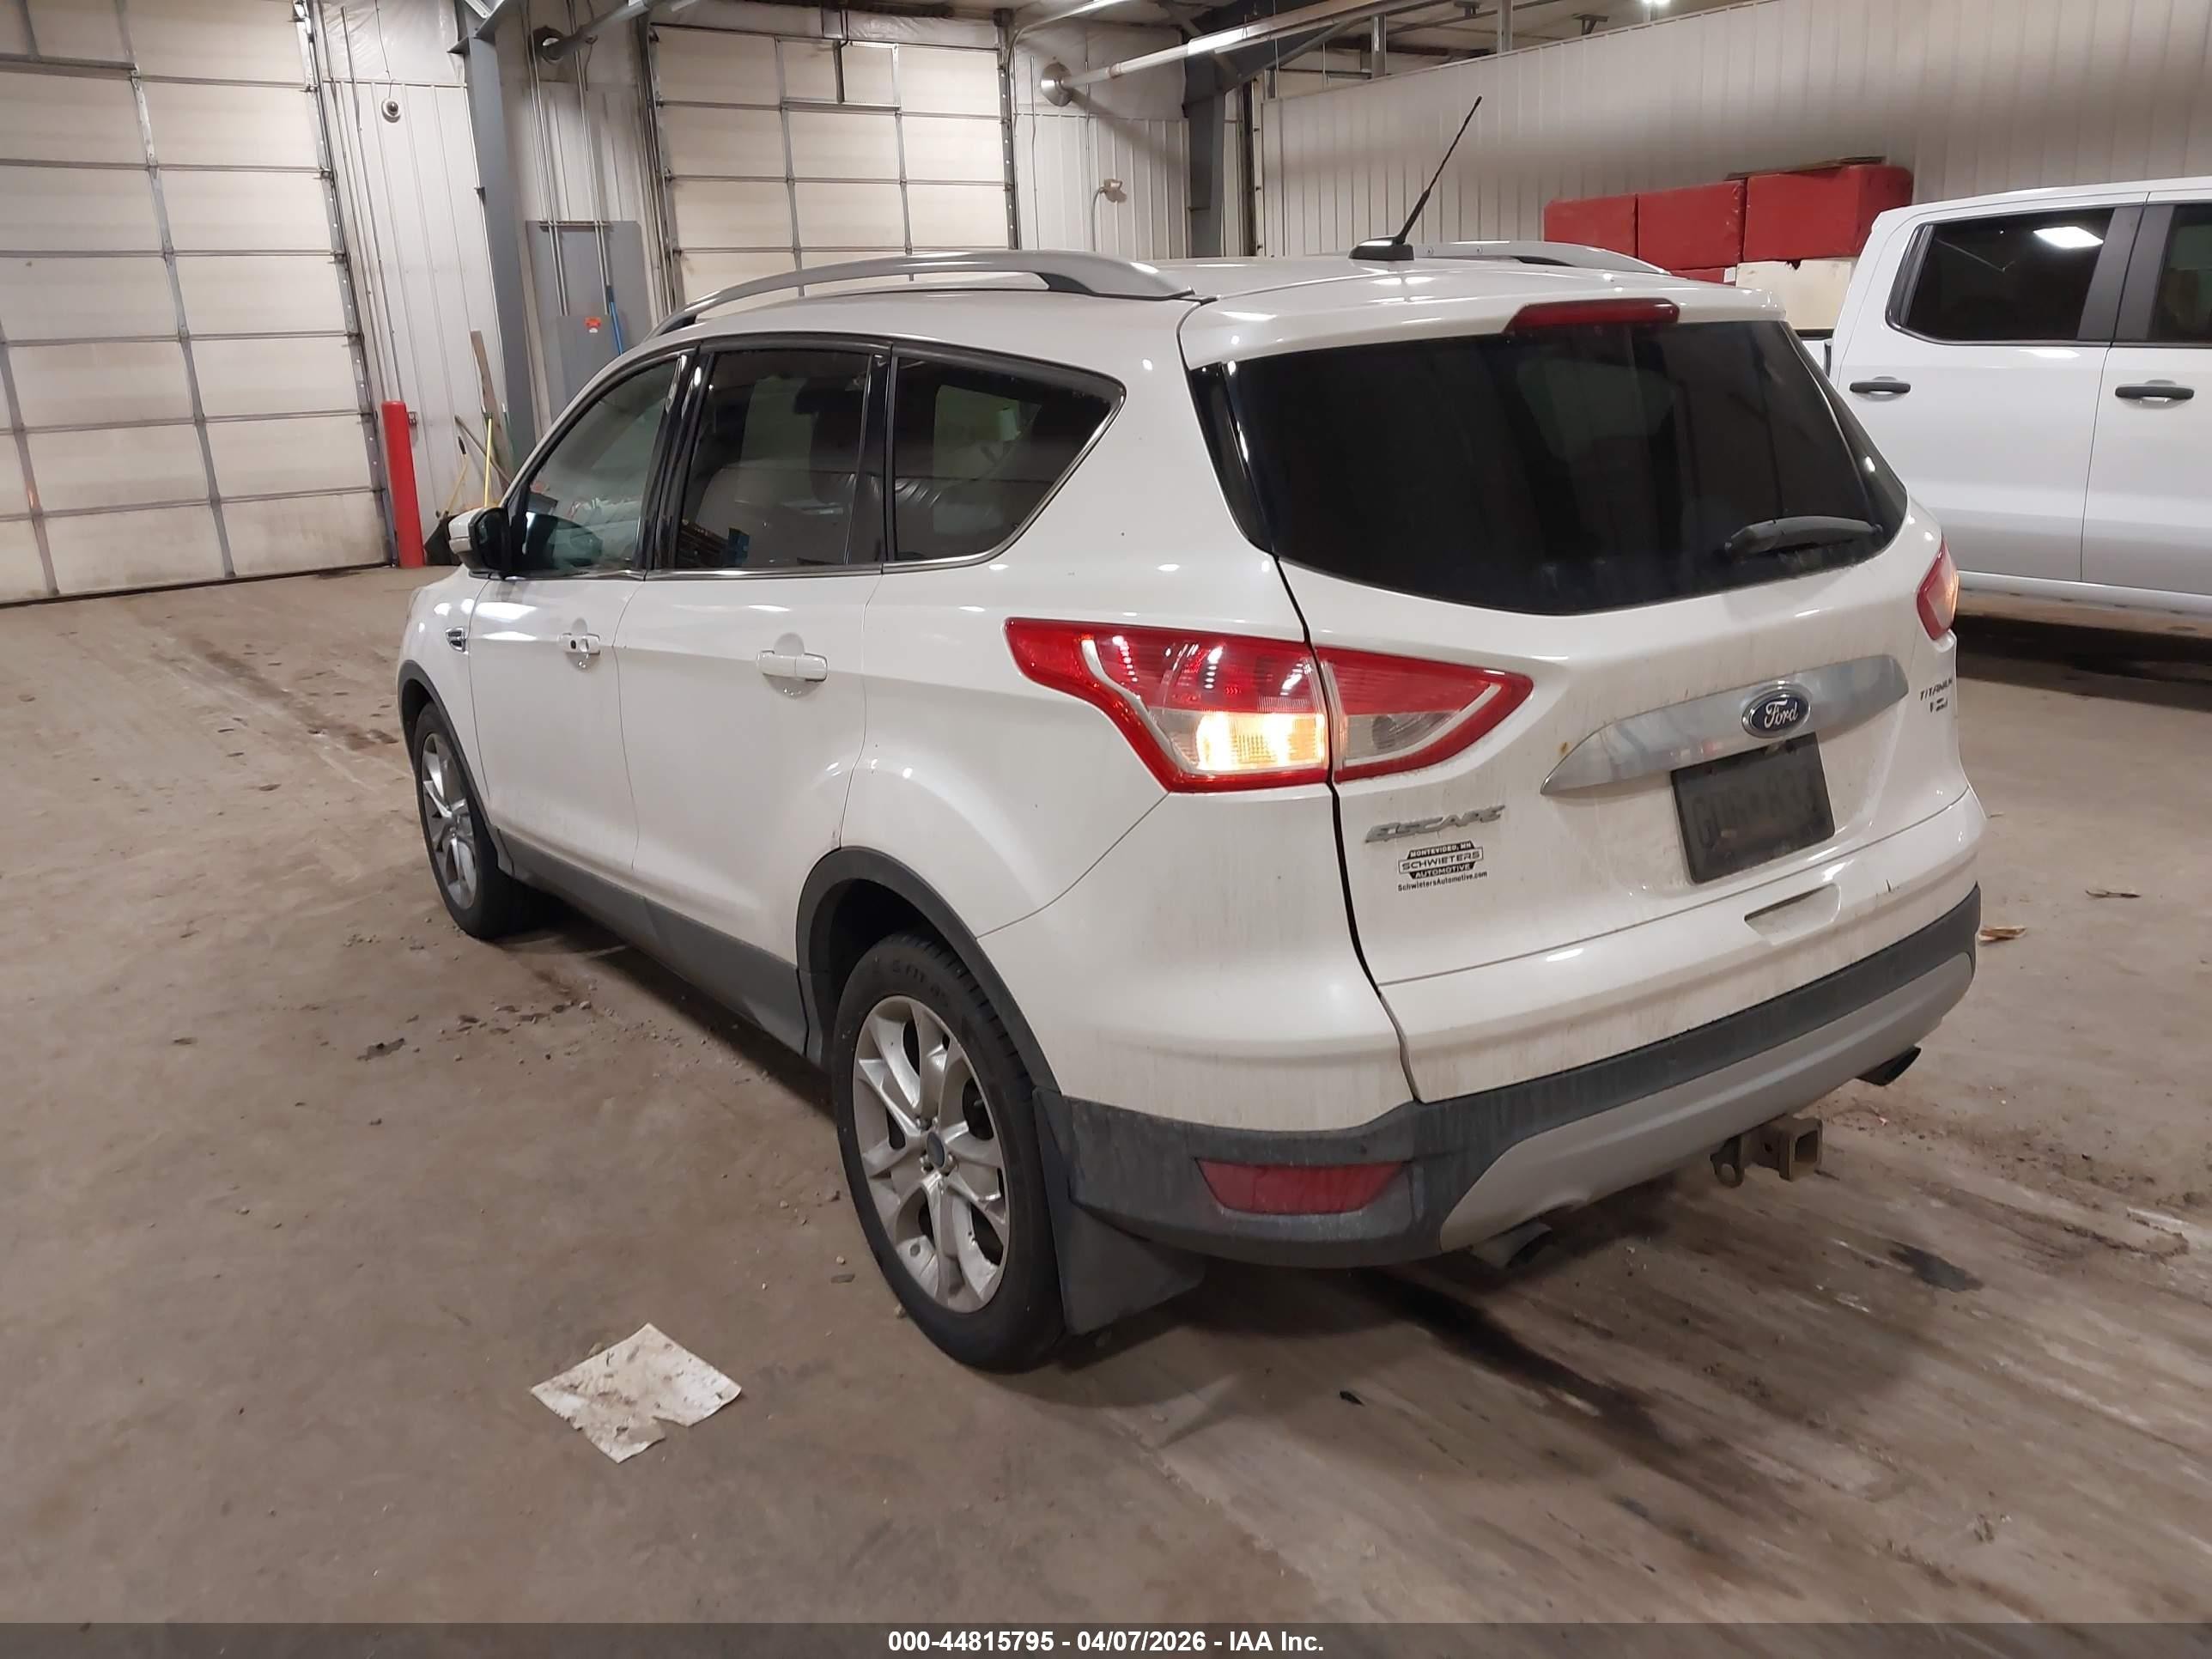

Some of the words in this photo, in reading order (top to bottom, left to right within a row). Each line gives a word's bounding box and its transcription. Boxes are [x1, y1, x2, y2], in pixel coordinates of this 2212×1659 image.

[1765, 699, 1799, 728] Ford
[1365, 805, 1505, 843] ESCAPE
[1401, 850, 1480, 871] SCHWIETERS
[1410, 844, 1459, 858] MONTEVIDEO,
[1398, 871, 1488, 892] SchwietersAutomotive.com
[1415, 863, 1470, 879] AUTOMOTIVE
